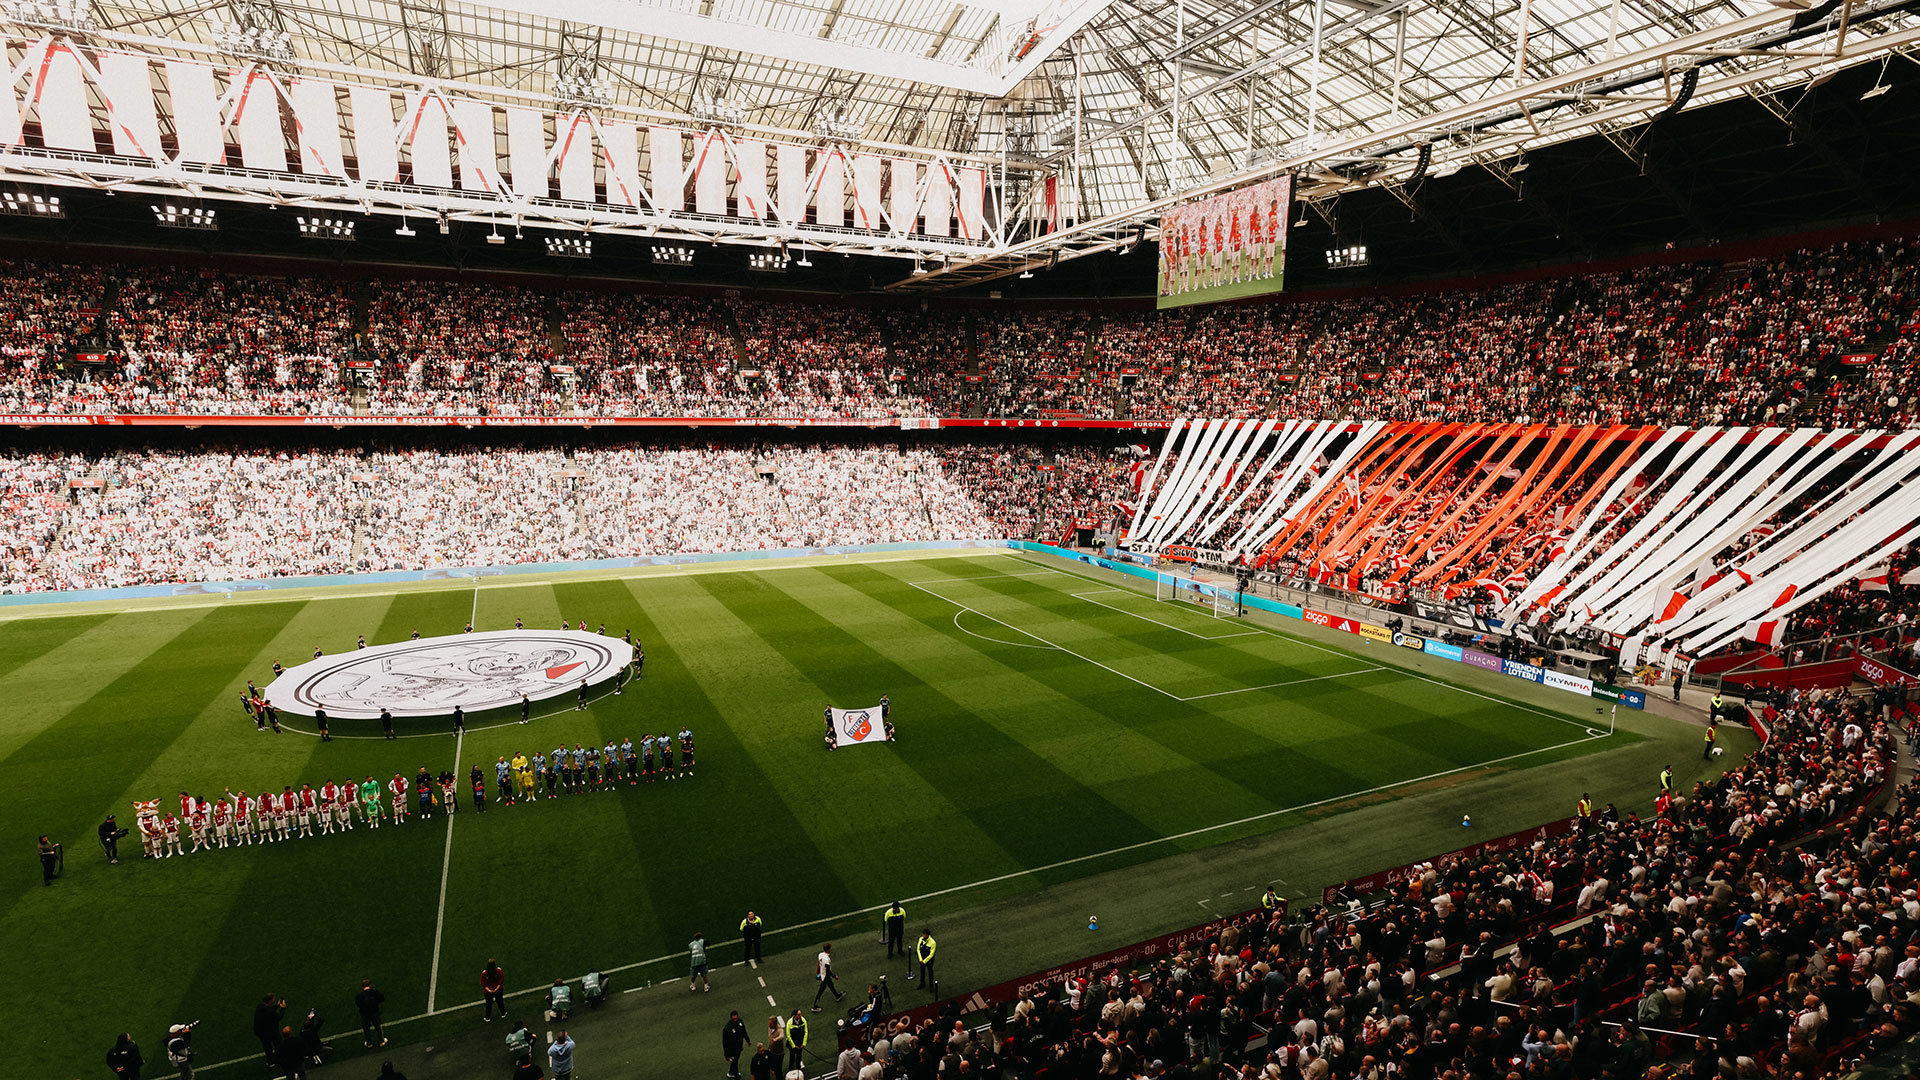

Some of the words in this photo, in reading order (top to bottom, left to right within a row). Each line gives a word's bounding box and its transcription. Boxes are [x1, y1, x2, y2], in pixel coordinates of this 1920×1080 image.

[1305, 610, 1328, 625] ziggo
[1504, 660, 1543, 676] VRIENDEN
[1508, 667, 1537, 682] LOTERIJ
[1861, 660, 1883, 679] ziggo
[1545, 675, 1590, 692] OLYMPIA
[1593, 686, 1619, 699] Heineken
[1018, 970, 1076, 993] ROCKTARS
[1078, 966, 1087, 976] IT
